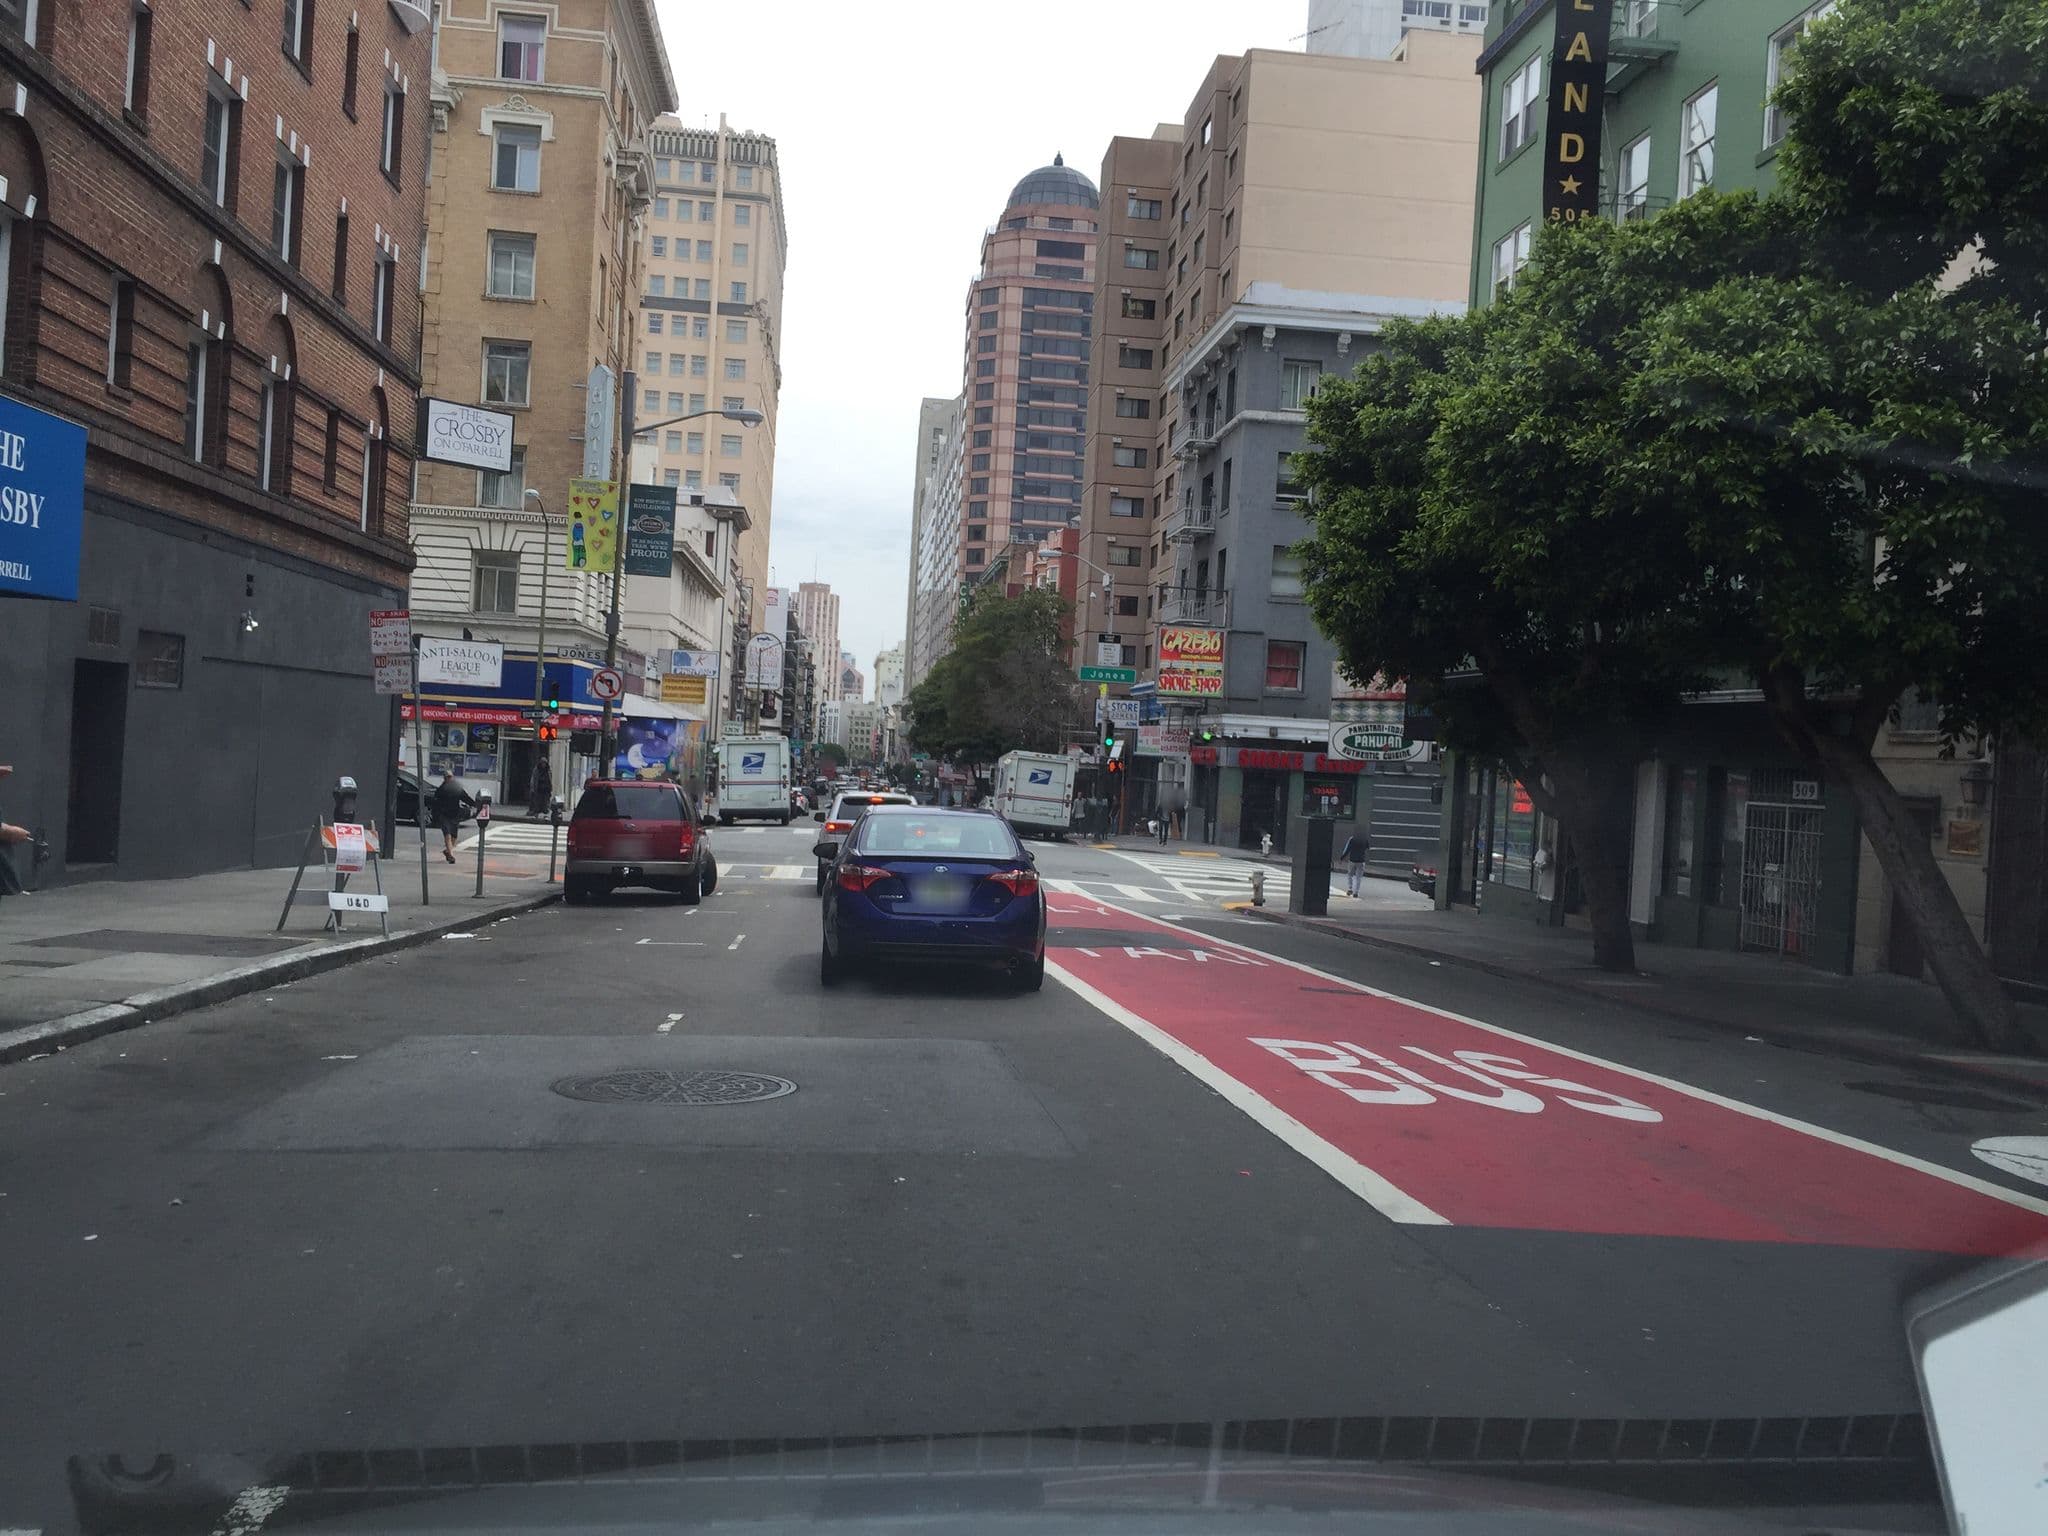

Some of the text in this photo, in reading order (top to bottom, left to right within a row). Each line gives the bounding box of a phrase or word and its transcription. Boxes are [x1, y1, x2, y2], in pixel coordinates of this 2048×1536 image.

[1560, 0, 1595, 164] AND
[434, 417, 506, 446] CROSBY
[433, 437, 451, 449] ON
[630, 548, 670, 560] PROUD.
[371, 618, 383, 627] NO
[561, 649, 601, 659] JONES
[375, 656, 386, 667] NO
[441, 660, 481, 672] LEAGUE
[1090, 670, 1125, 680] Jones
[1111, 702, 1138, 712] STORE
[452, 711, 471, 719] PRICES
[495, 714, 517, 722] LIQUOR
[1238, 748, 1305, 769] SMOKE
[1246, 1036, 1664, 1124] BUS
